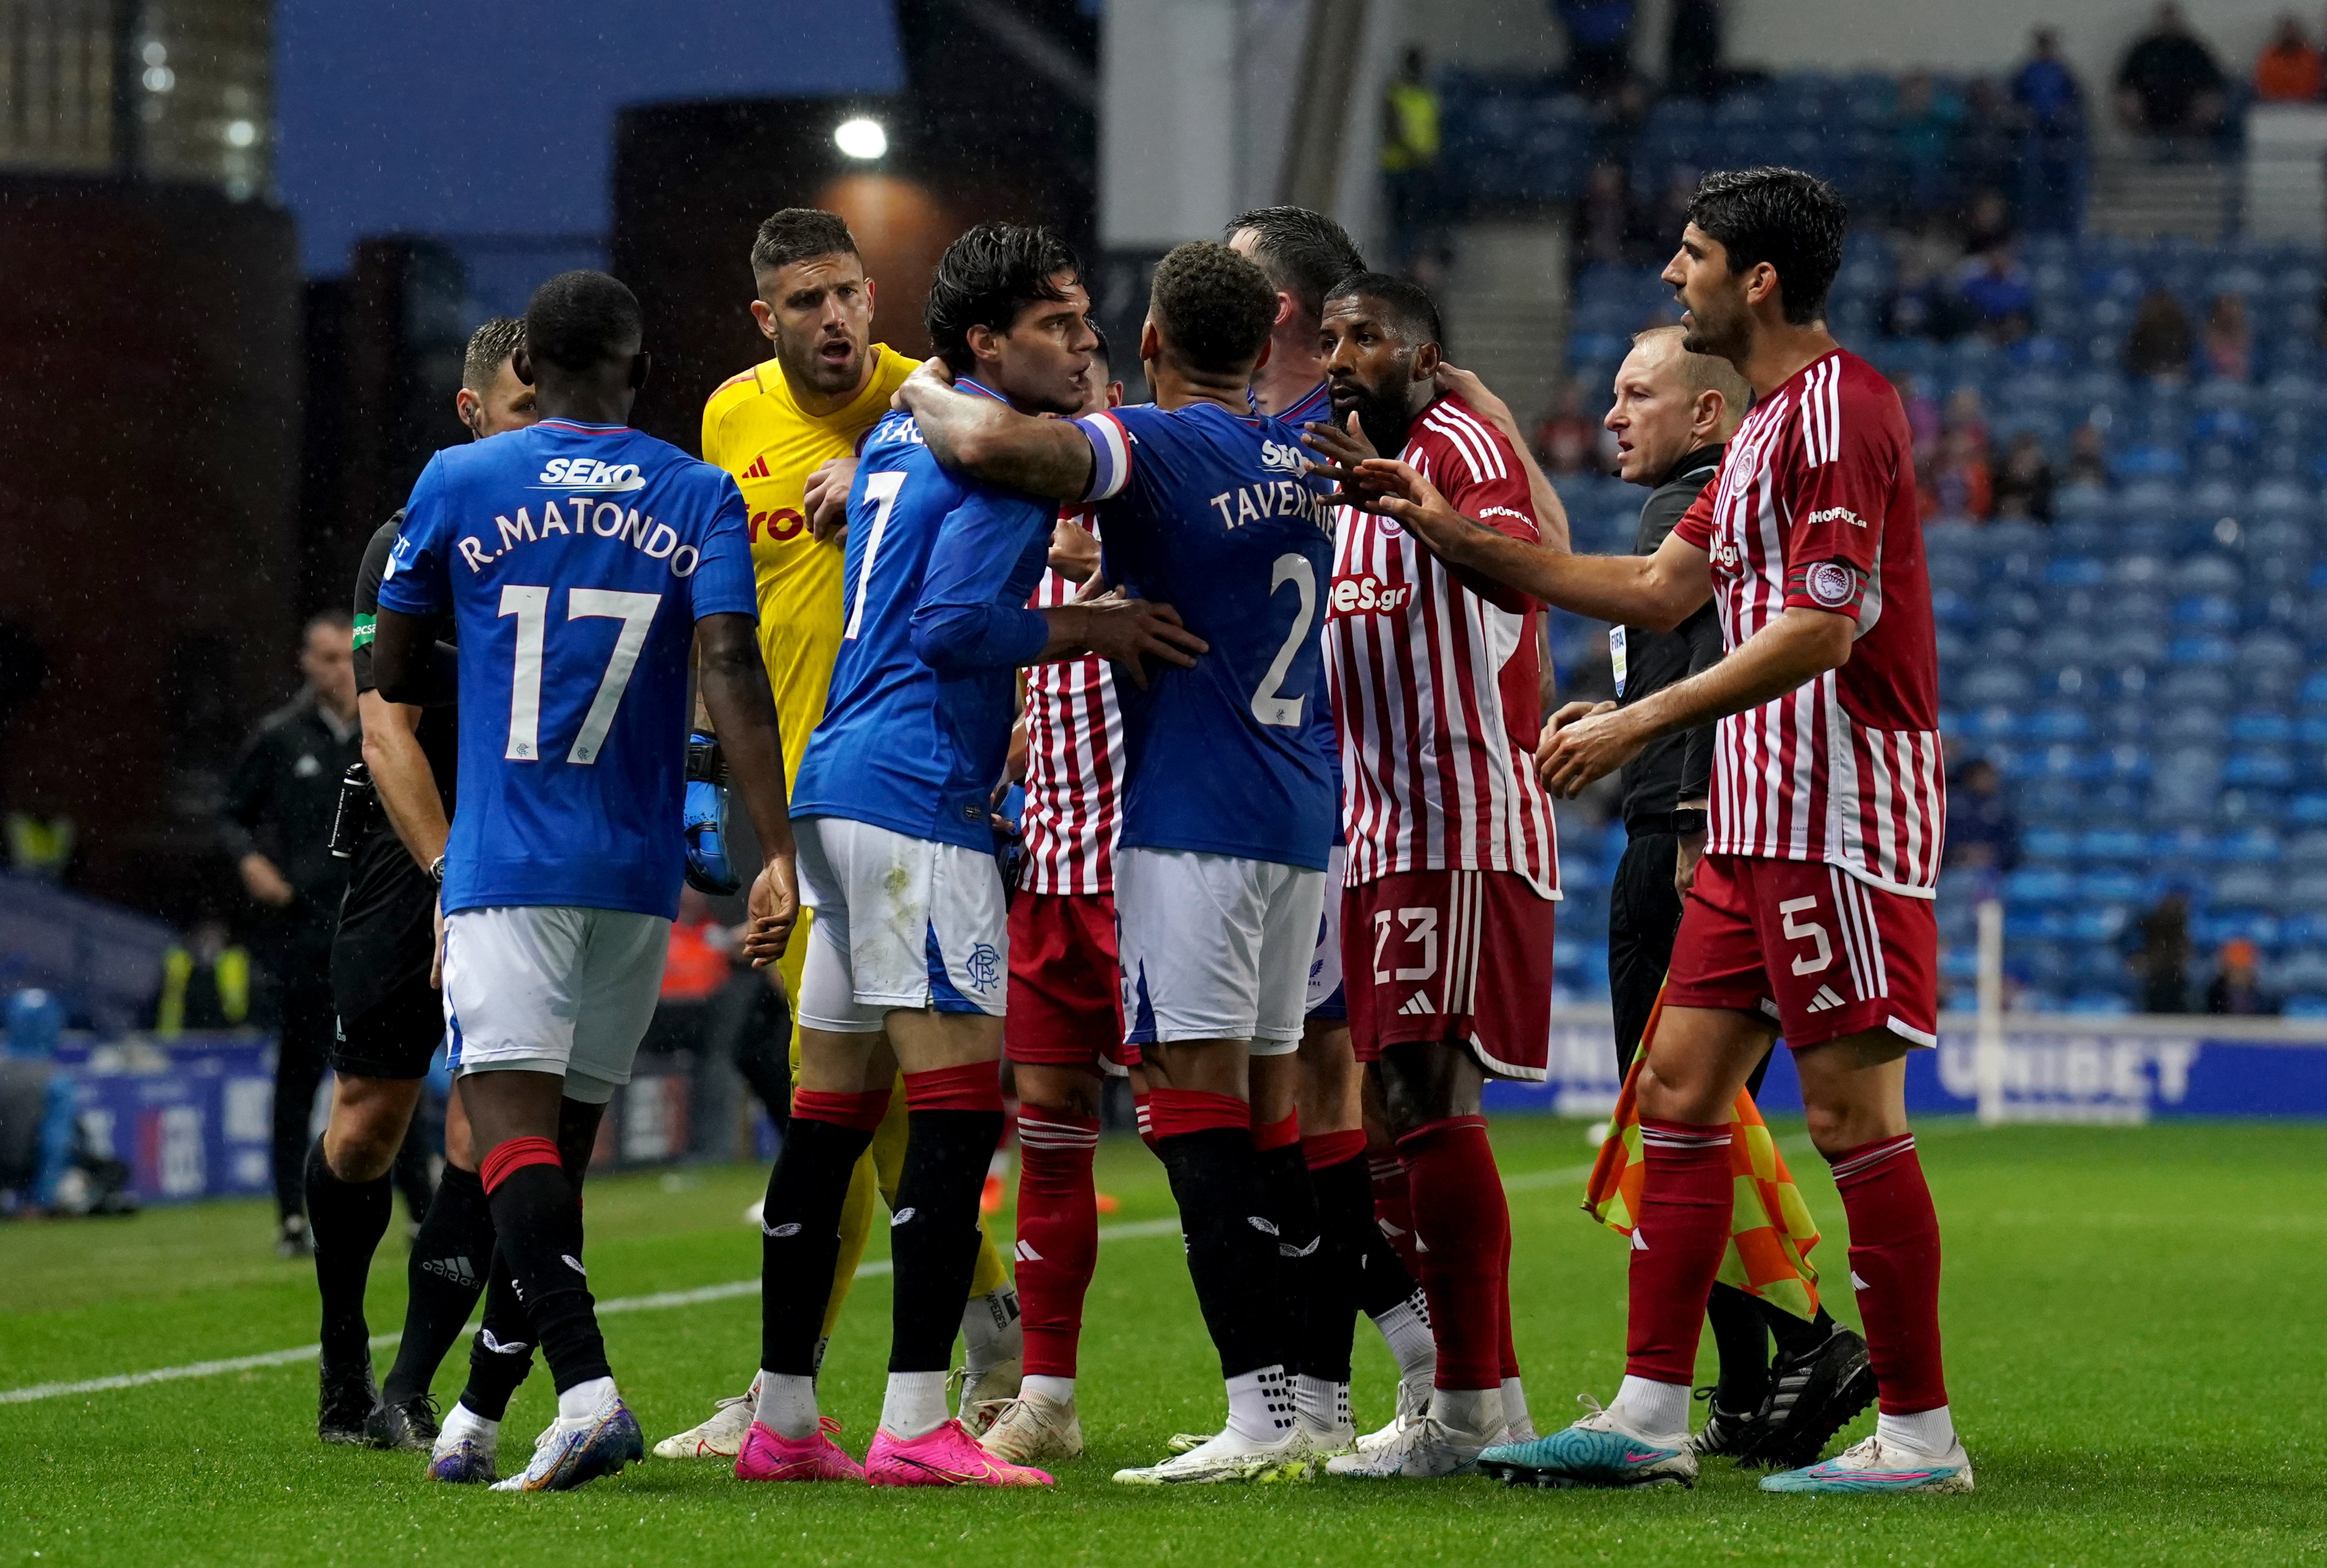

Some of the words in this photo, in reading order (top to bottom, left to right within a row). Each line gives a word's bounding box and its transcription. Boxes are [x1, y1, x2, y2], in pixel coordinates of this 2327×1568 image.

[539, 458, 647, 490] SEKO
[457, 497, 700, 578] R.MATONDO
[844, 471, 908, 640] 7
[1210, 481, 1336, 550] TAVERNIE
[497, 584, 662, 765] 17
[1250, 552, 1316, 727] 2
[1611, 630, 1624, 651] FIFA
[1372, 907, 1438, 986] 23
[1778, 894, 1834, 977] 5
[422, 1261, 481, 1290] adidas
